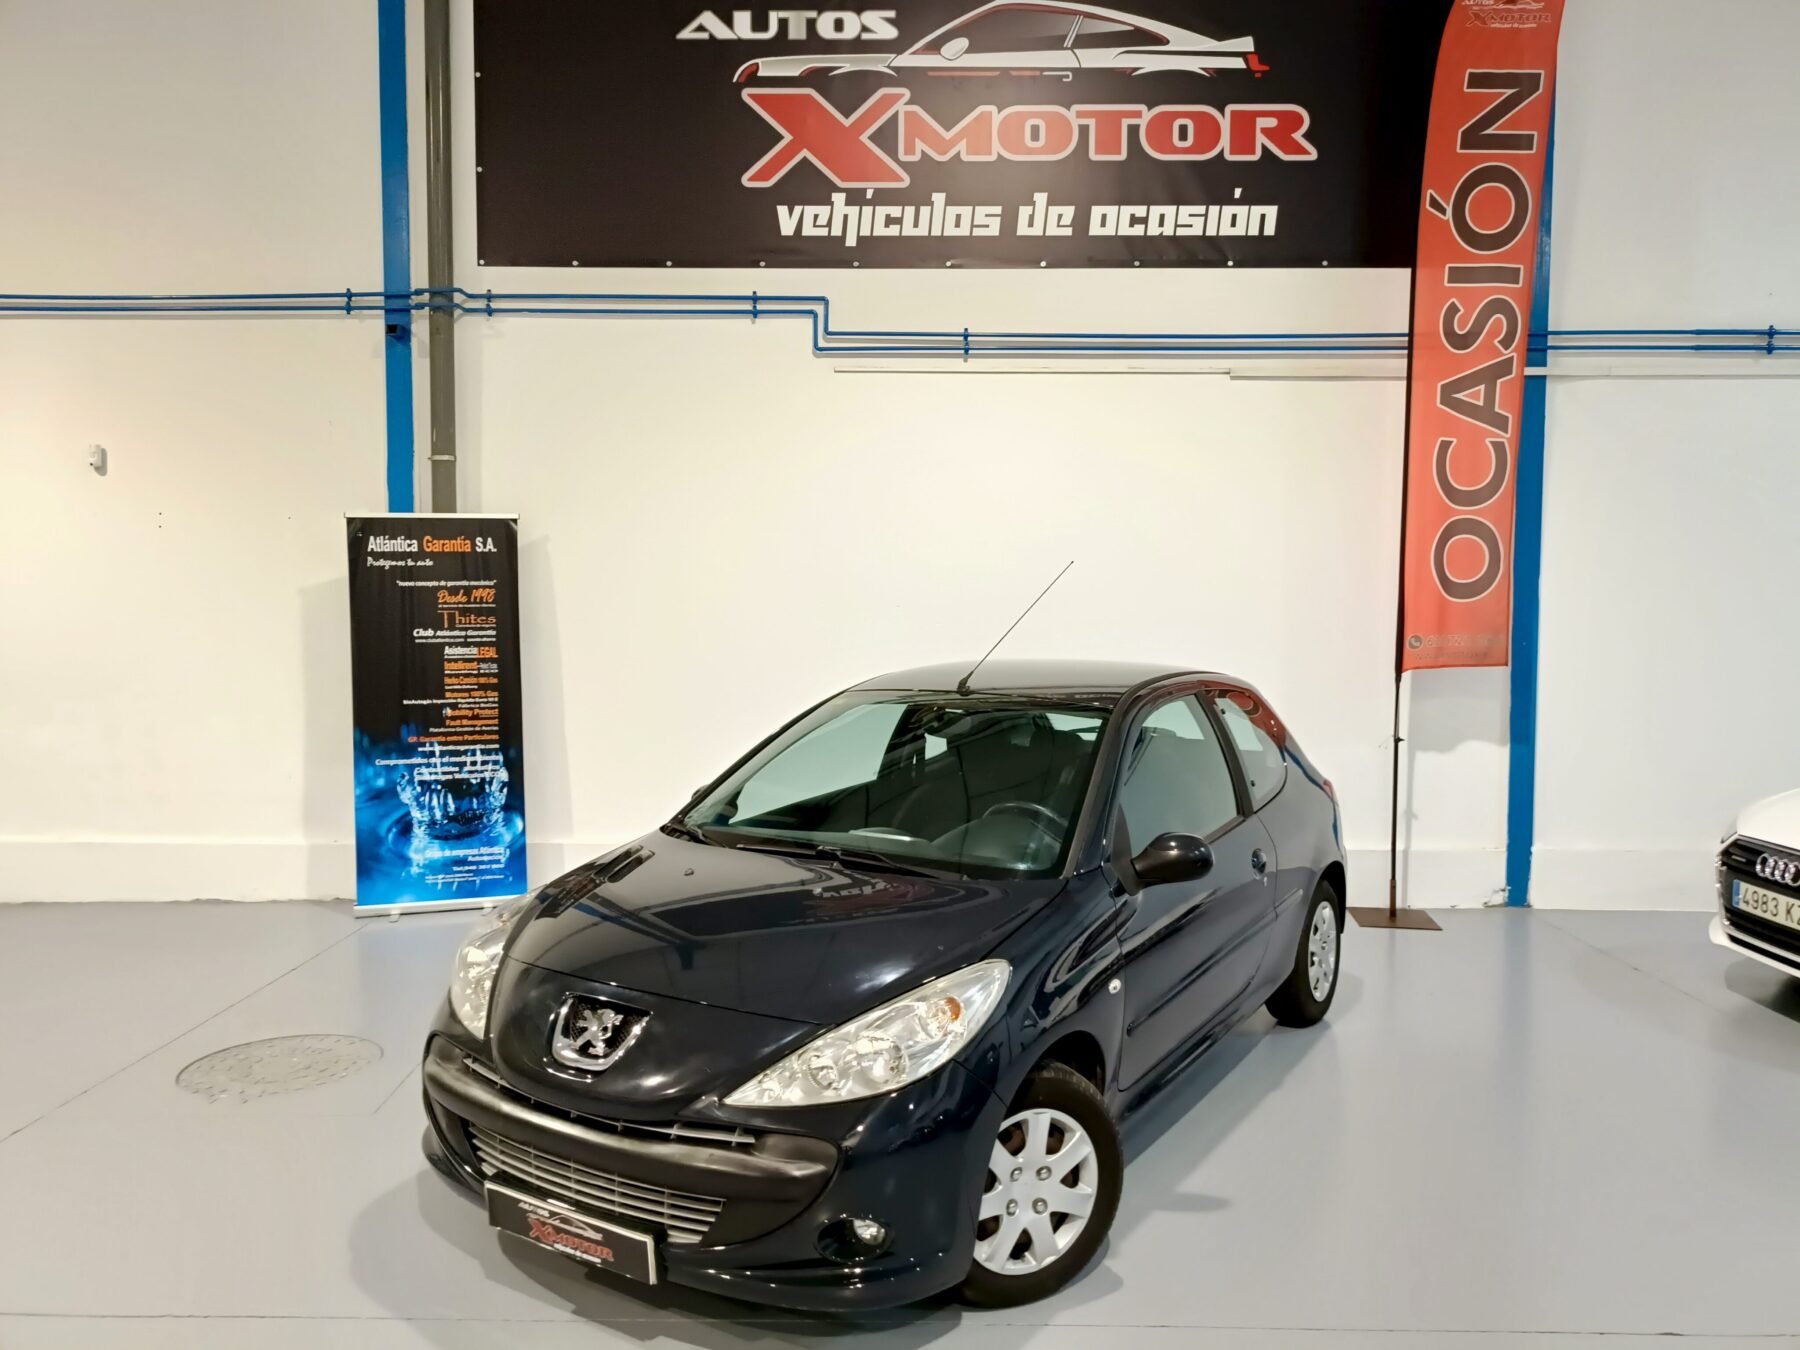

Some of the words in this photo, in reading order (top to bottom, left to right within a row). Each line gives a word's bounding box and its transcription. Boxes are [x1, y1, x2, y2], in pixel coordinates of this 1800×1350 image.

[676, 9, 898, 41] AUTOS
[777, 189, 1002, 248] vehículos
[1016, 192, 1075, 238] de
[1088, 187, 1279, 238] ocasión
[1426, 68, 1545, 603] OCASIÓN
[367, 536, 418, 552] Atlántica
[423, 536, 471, 552] Garantía
[475, 537, 497, 552] S.A.
[437, 590, 468, 603] Desde
[470, 588, 496, 602] 1998
[413, 629, 434, 637] Club
[1742, 888, 1779, 917] 4983
